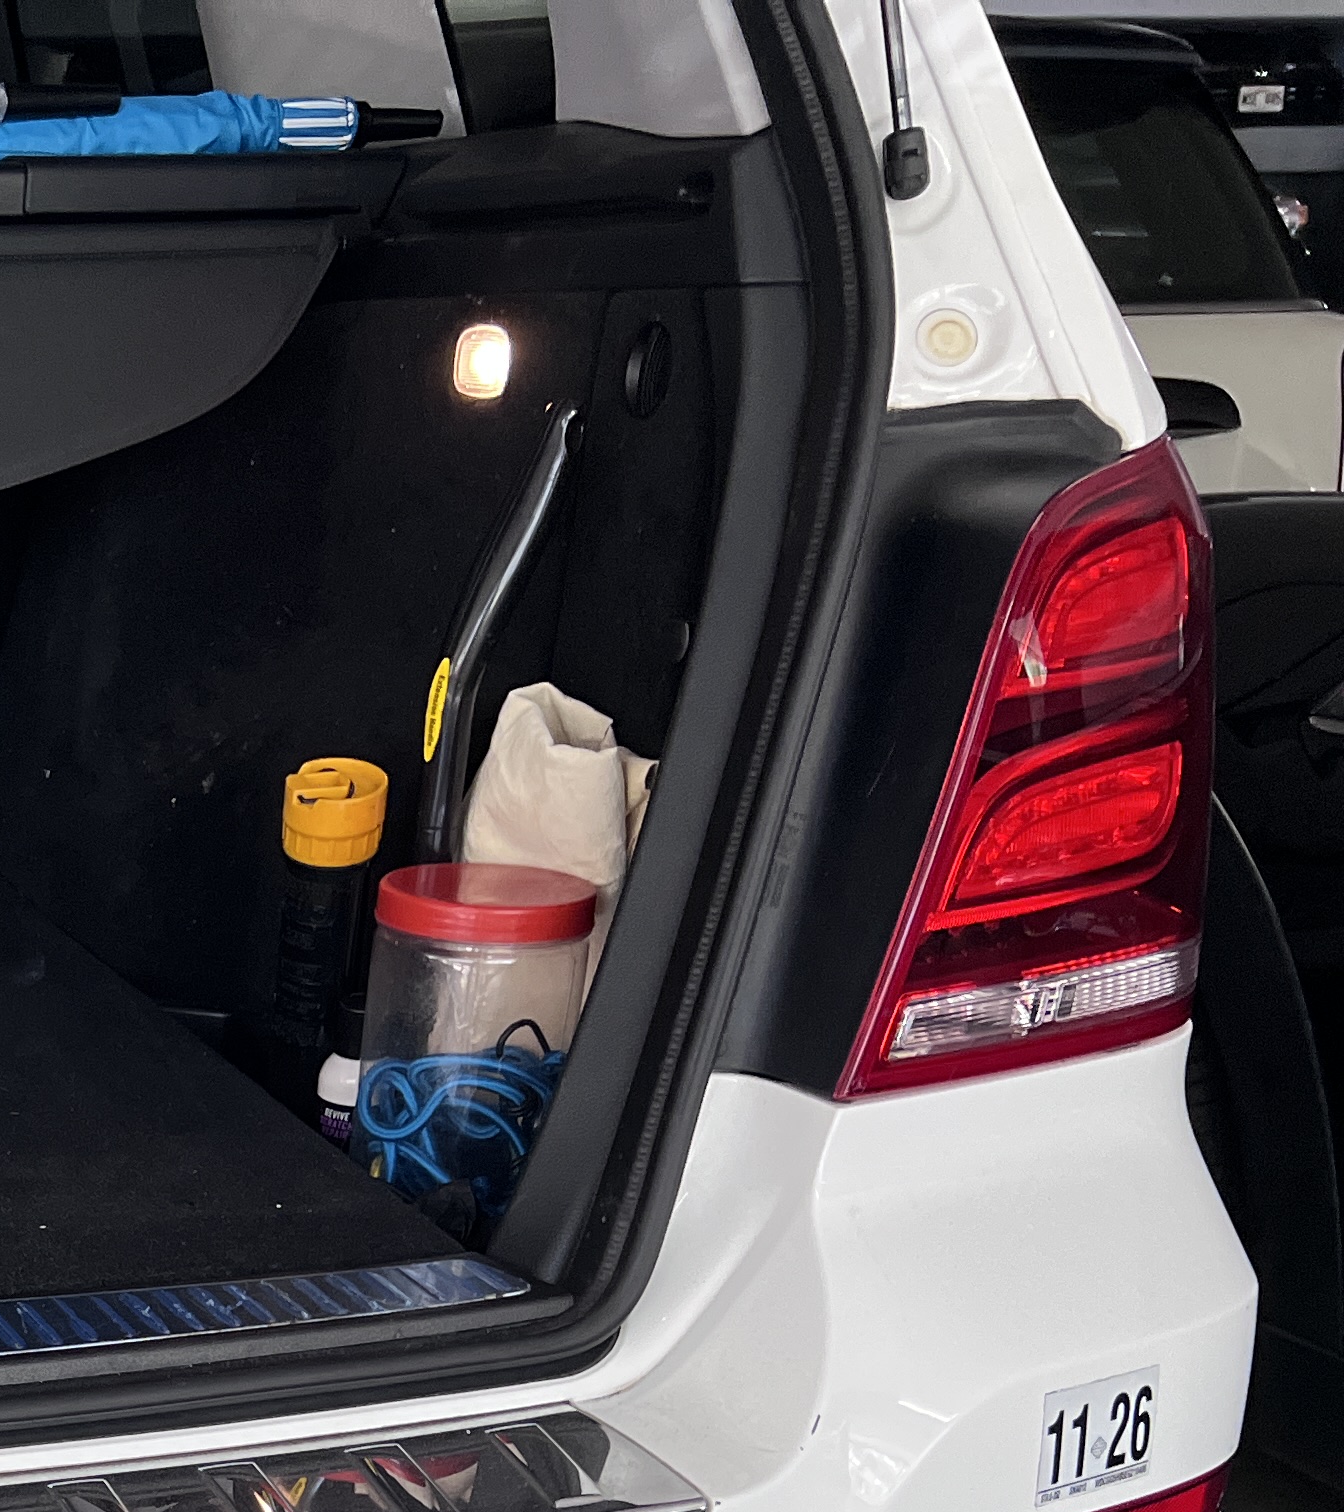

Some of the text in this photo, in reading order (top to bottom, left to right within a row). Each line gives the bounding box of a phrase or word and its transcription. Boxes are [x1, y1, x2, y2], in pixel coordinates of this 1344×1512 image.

[431, 674, 446, 715] Extension
[324, 1107, 351, 1122] REVIVE
[1047, 1385, 1153, 1485] 11 26
